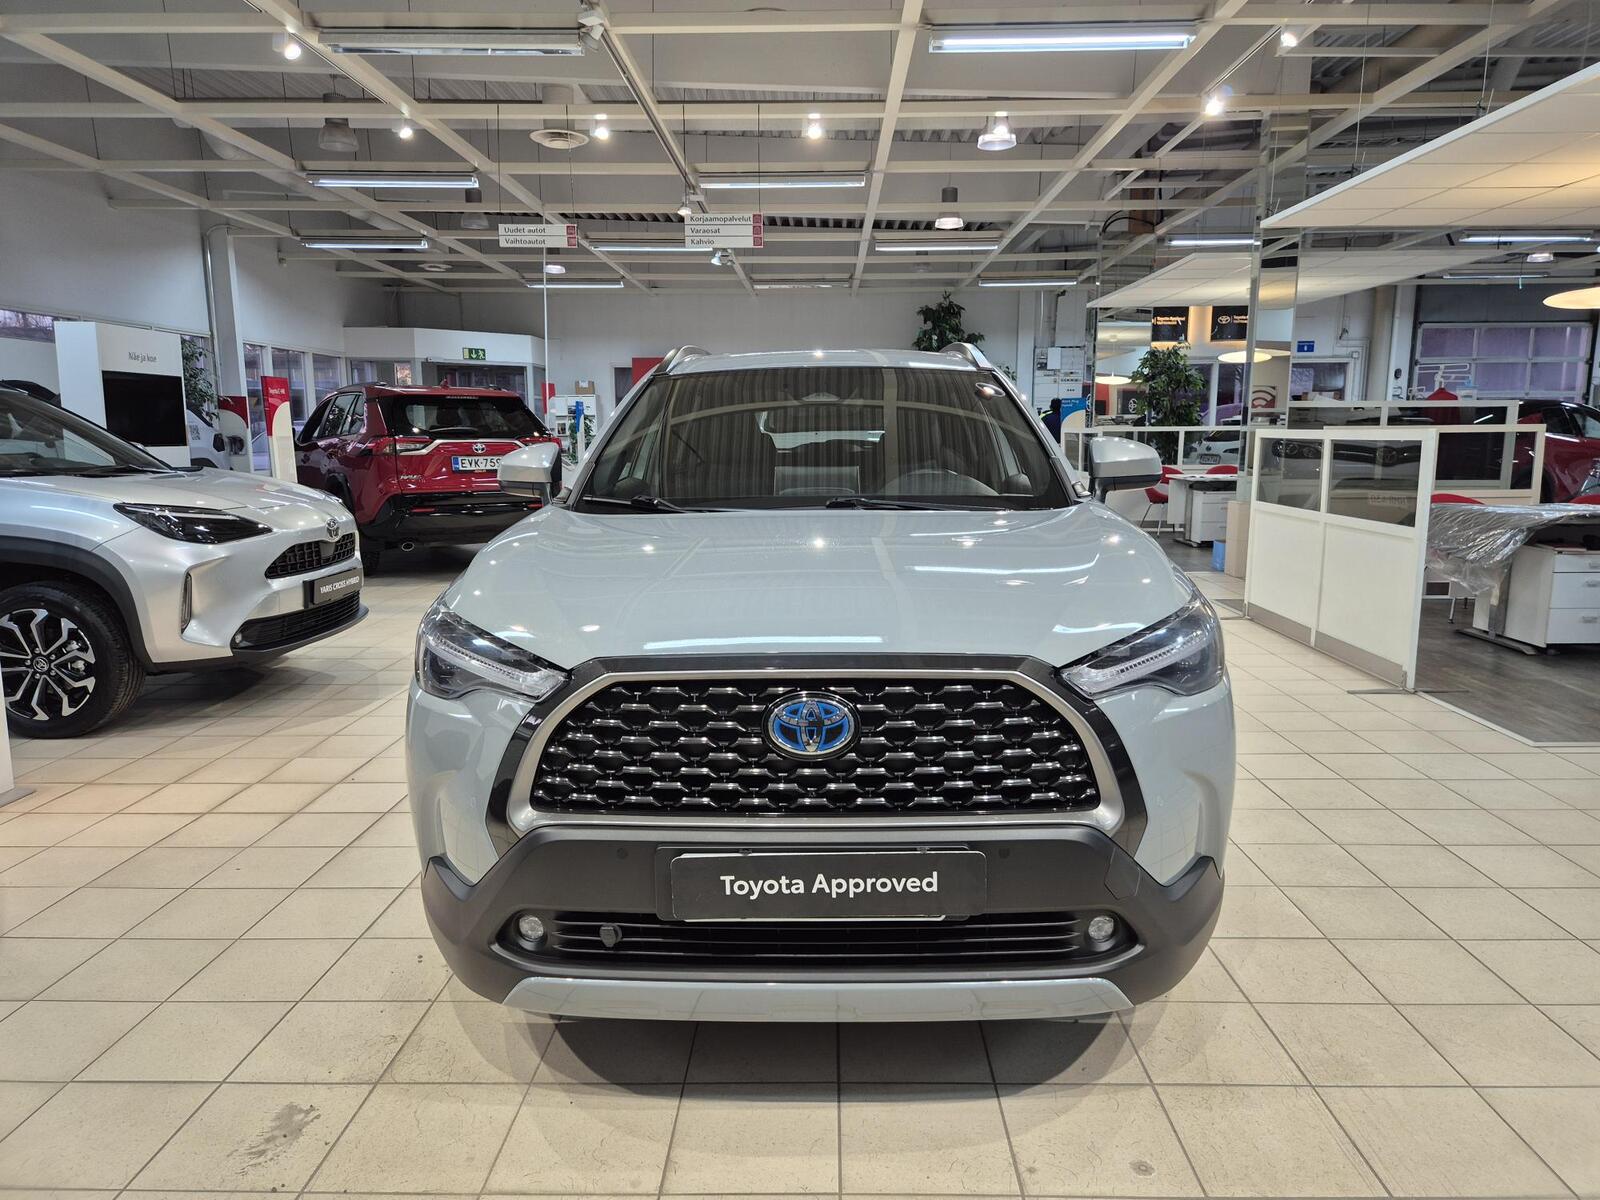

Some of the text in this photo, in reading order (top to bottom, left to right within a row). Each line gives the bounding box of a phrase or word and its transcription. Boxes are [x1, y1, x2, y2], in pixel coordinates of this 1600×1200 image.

[689, 215, 752, 223] Korjaamopalvelut
[503, 226, 547, 234] Uudet autot
[504, 237, 547, 245] Vaihtoautot
[320, 575, 360, 593] YARIS CROSS HYBRID
[719, 871, 938, 900] Toyota Approved
